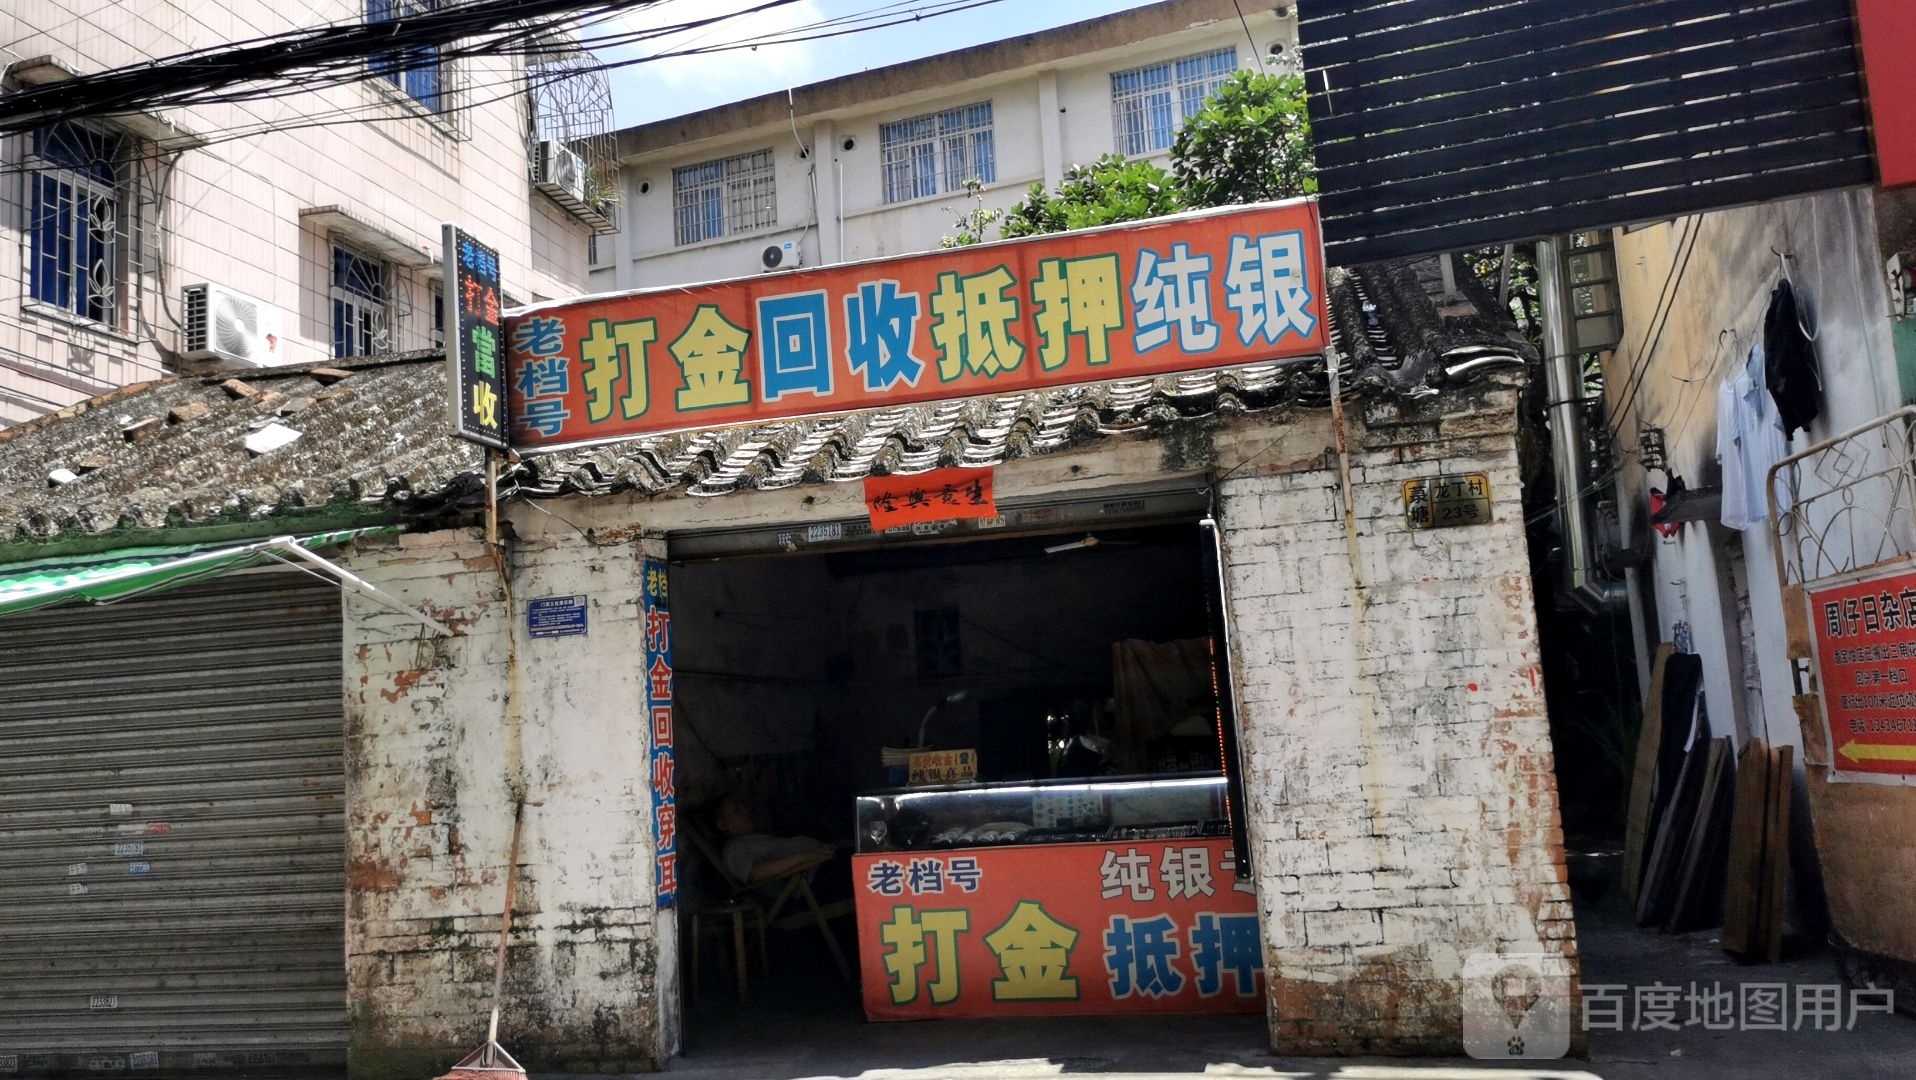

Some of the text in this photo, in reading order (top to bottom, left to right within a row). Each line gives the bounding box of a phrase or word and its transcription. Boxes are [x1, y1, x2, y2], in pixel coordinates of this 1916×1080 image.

[461, 242, 497, 282] 老档号
[464, 275, 499, 326] 打金
[581, 227, 1317, 425] 打金回收抵押纯银
[513, 315, 570, 438] 老档号
[1434, 480, 1483, 498] 龙丁村
[1442, 503, 1479, 520] 23号
[1825, 587, 1916, 639] 周仔日杂店
[647, 605, 677, 897] 打金回收穿耳
[867, 858, 983, 896] 老档号
[880, 900, 1265, 1007] 打金 抵押
